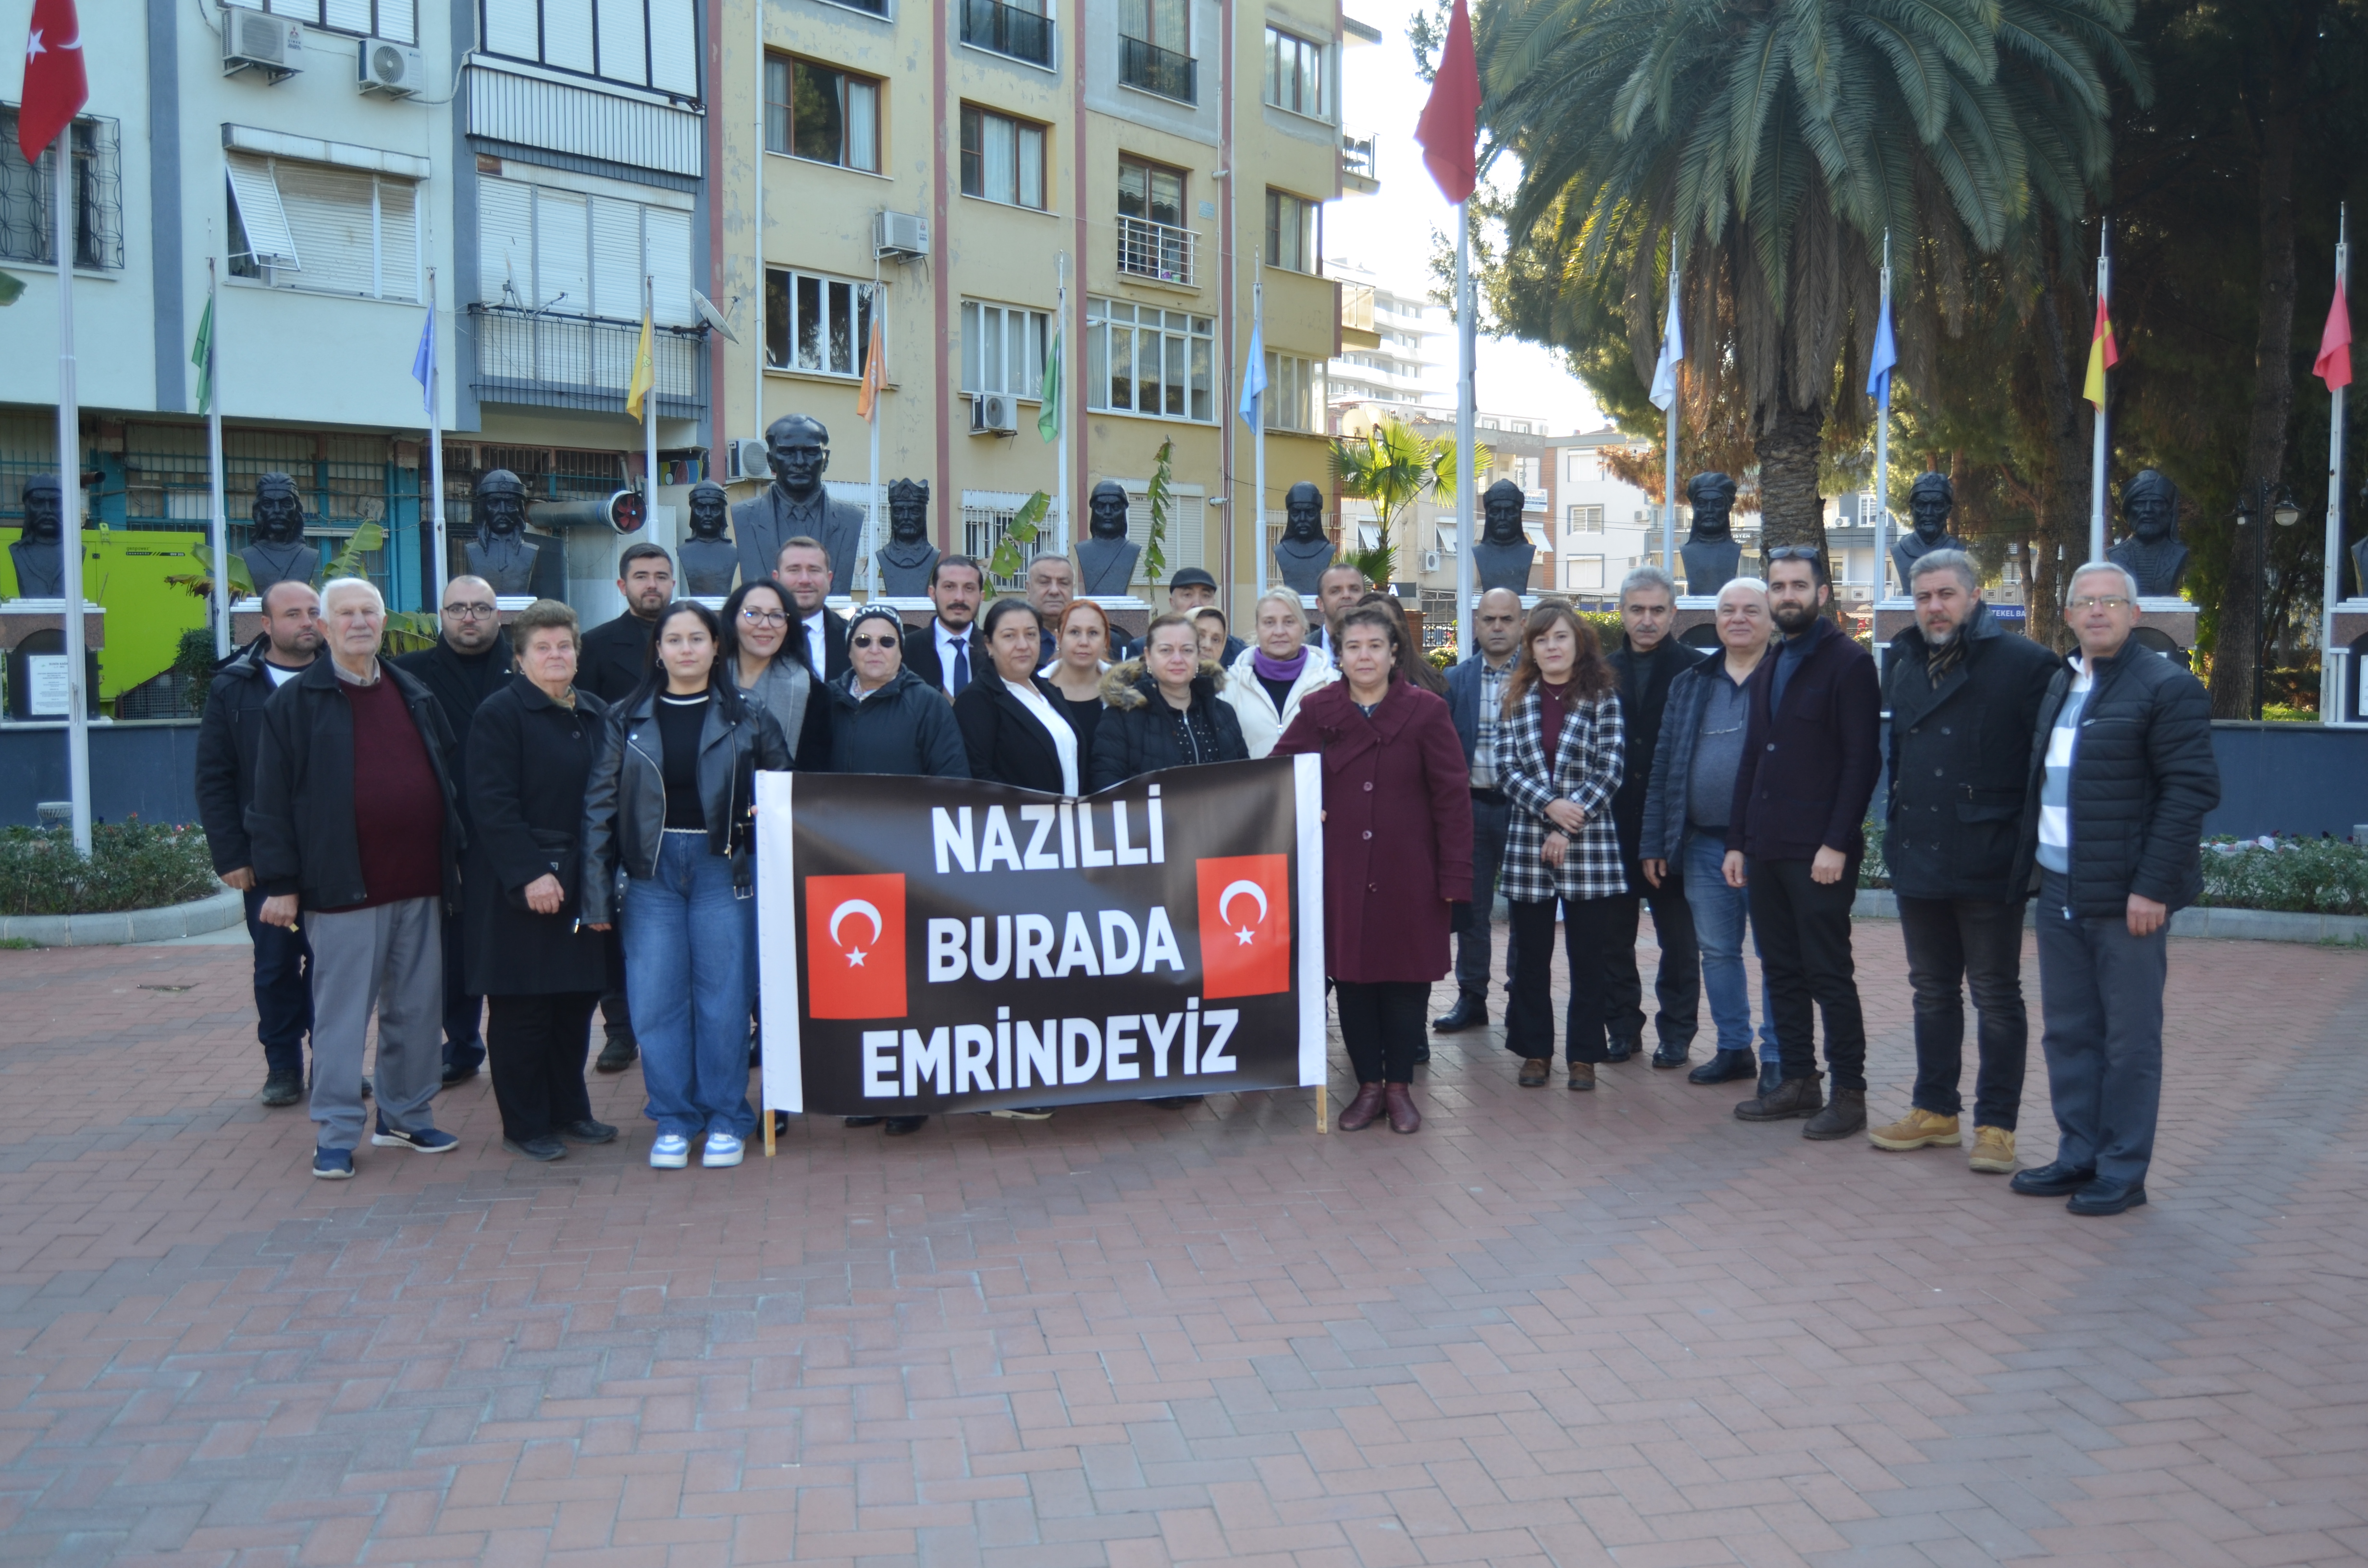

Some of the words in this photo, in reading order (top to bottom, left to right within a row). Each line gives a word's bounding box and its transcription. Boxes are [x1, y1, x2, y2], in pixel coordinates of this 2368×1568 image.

[932, 784, 1165, 873] NAZİLLİ
[928, 906, 1185, 983] BURADA
[863, 997, 1239, 1098] EMRİNDEYİZ
